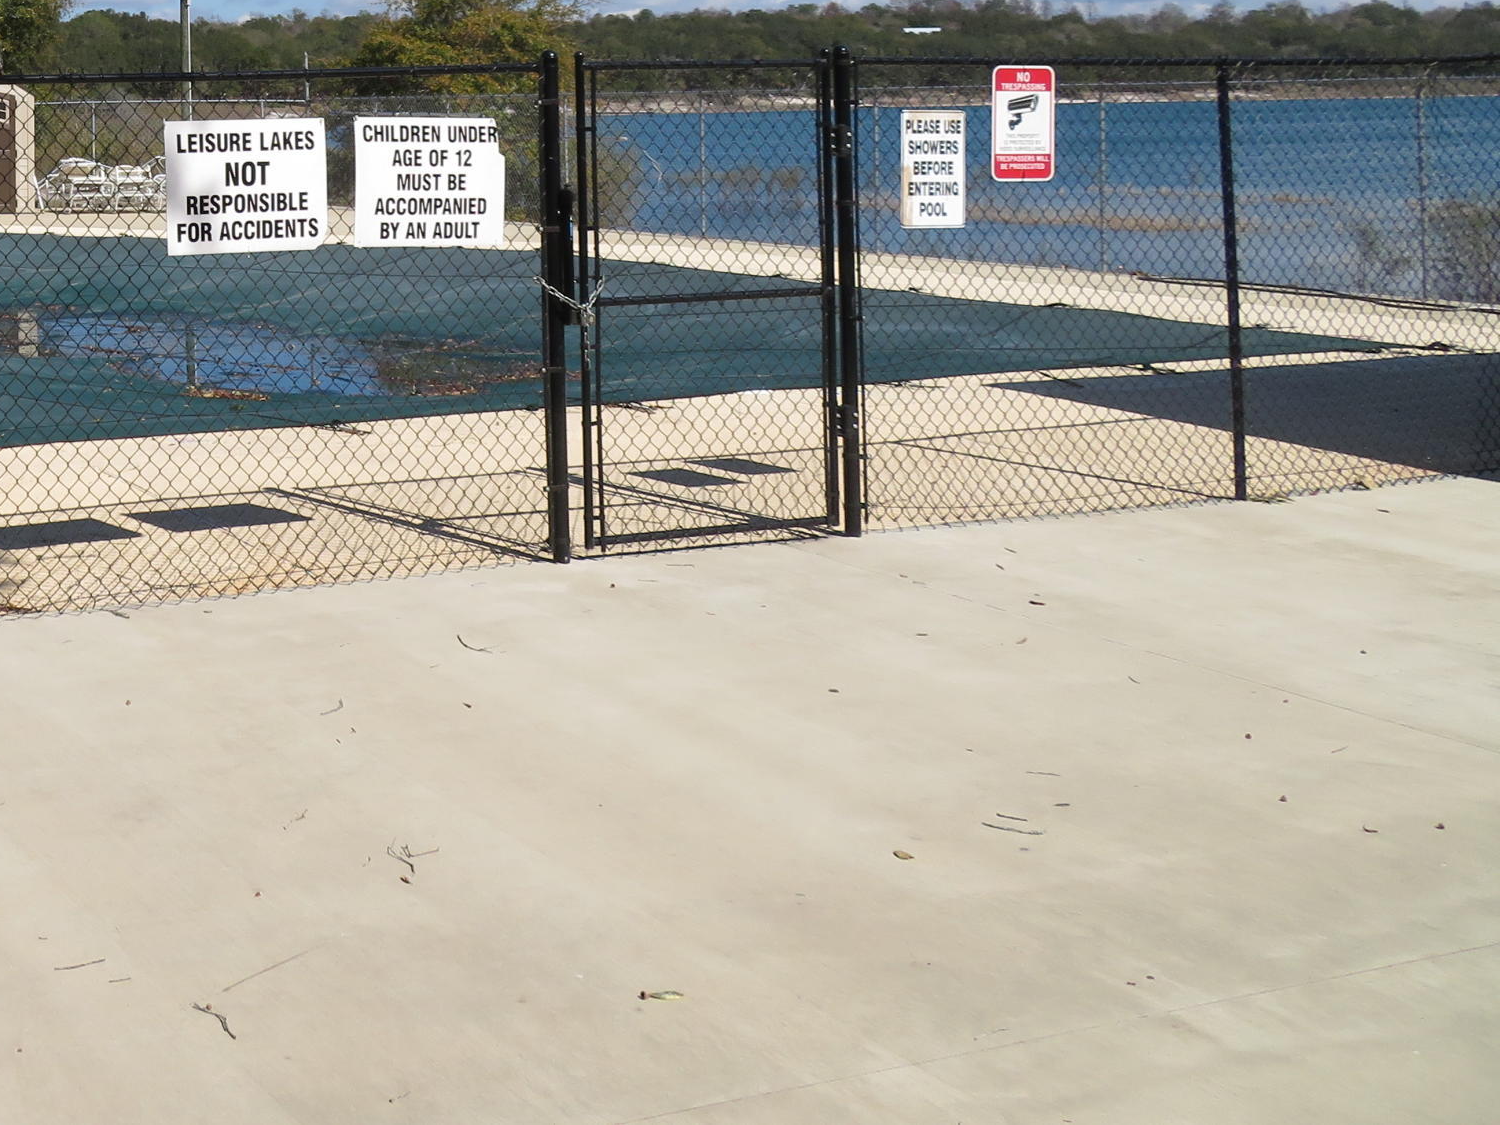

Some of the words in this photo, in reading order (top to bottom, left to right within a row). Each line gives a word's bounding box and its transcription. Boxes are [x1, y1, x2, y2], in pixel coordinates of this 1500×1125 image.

[1016, 71, 1031, 82] NO
[362, 124, 441, 143] CHILDREN
[447, 125, 497, 144] UNDER
[905, 119, 941, 135] PLEASE
[943, 119, 962, 134] USE
[176, 132, 253, 154] LEISURE
[259, 130, 315, 151] LAKES
[907, 140, 959, 155] SHOWERS
[392, 149, 423, 168] AGE
[428, 149, 449, 168] OF
[454, 149, 473, 168] 12
[224, 160, 270, 187] NOT
[912, 161, 954, 176] BEFORE
[396, 173, 442, 192] MUST
[447, 174, 467, 191] BE
[908, 182, 959, 197] ENTERING
[185, 191, 309, 216] RESPONSIBLE
[374, 197, 488, 216] ACCOMPANIED
[919, 202, 948, 217] POOL
[176, 222, 213, 244] FOR
[219, 217, 319, 241] ACCIDENTS
[379, 222, 401, 241] BY
[405, 222, 427, 240] AN
[432, 221, 481, 240] ADULT
